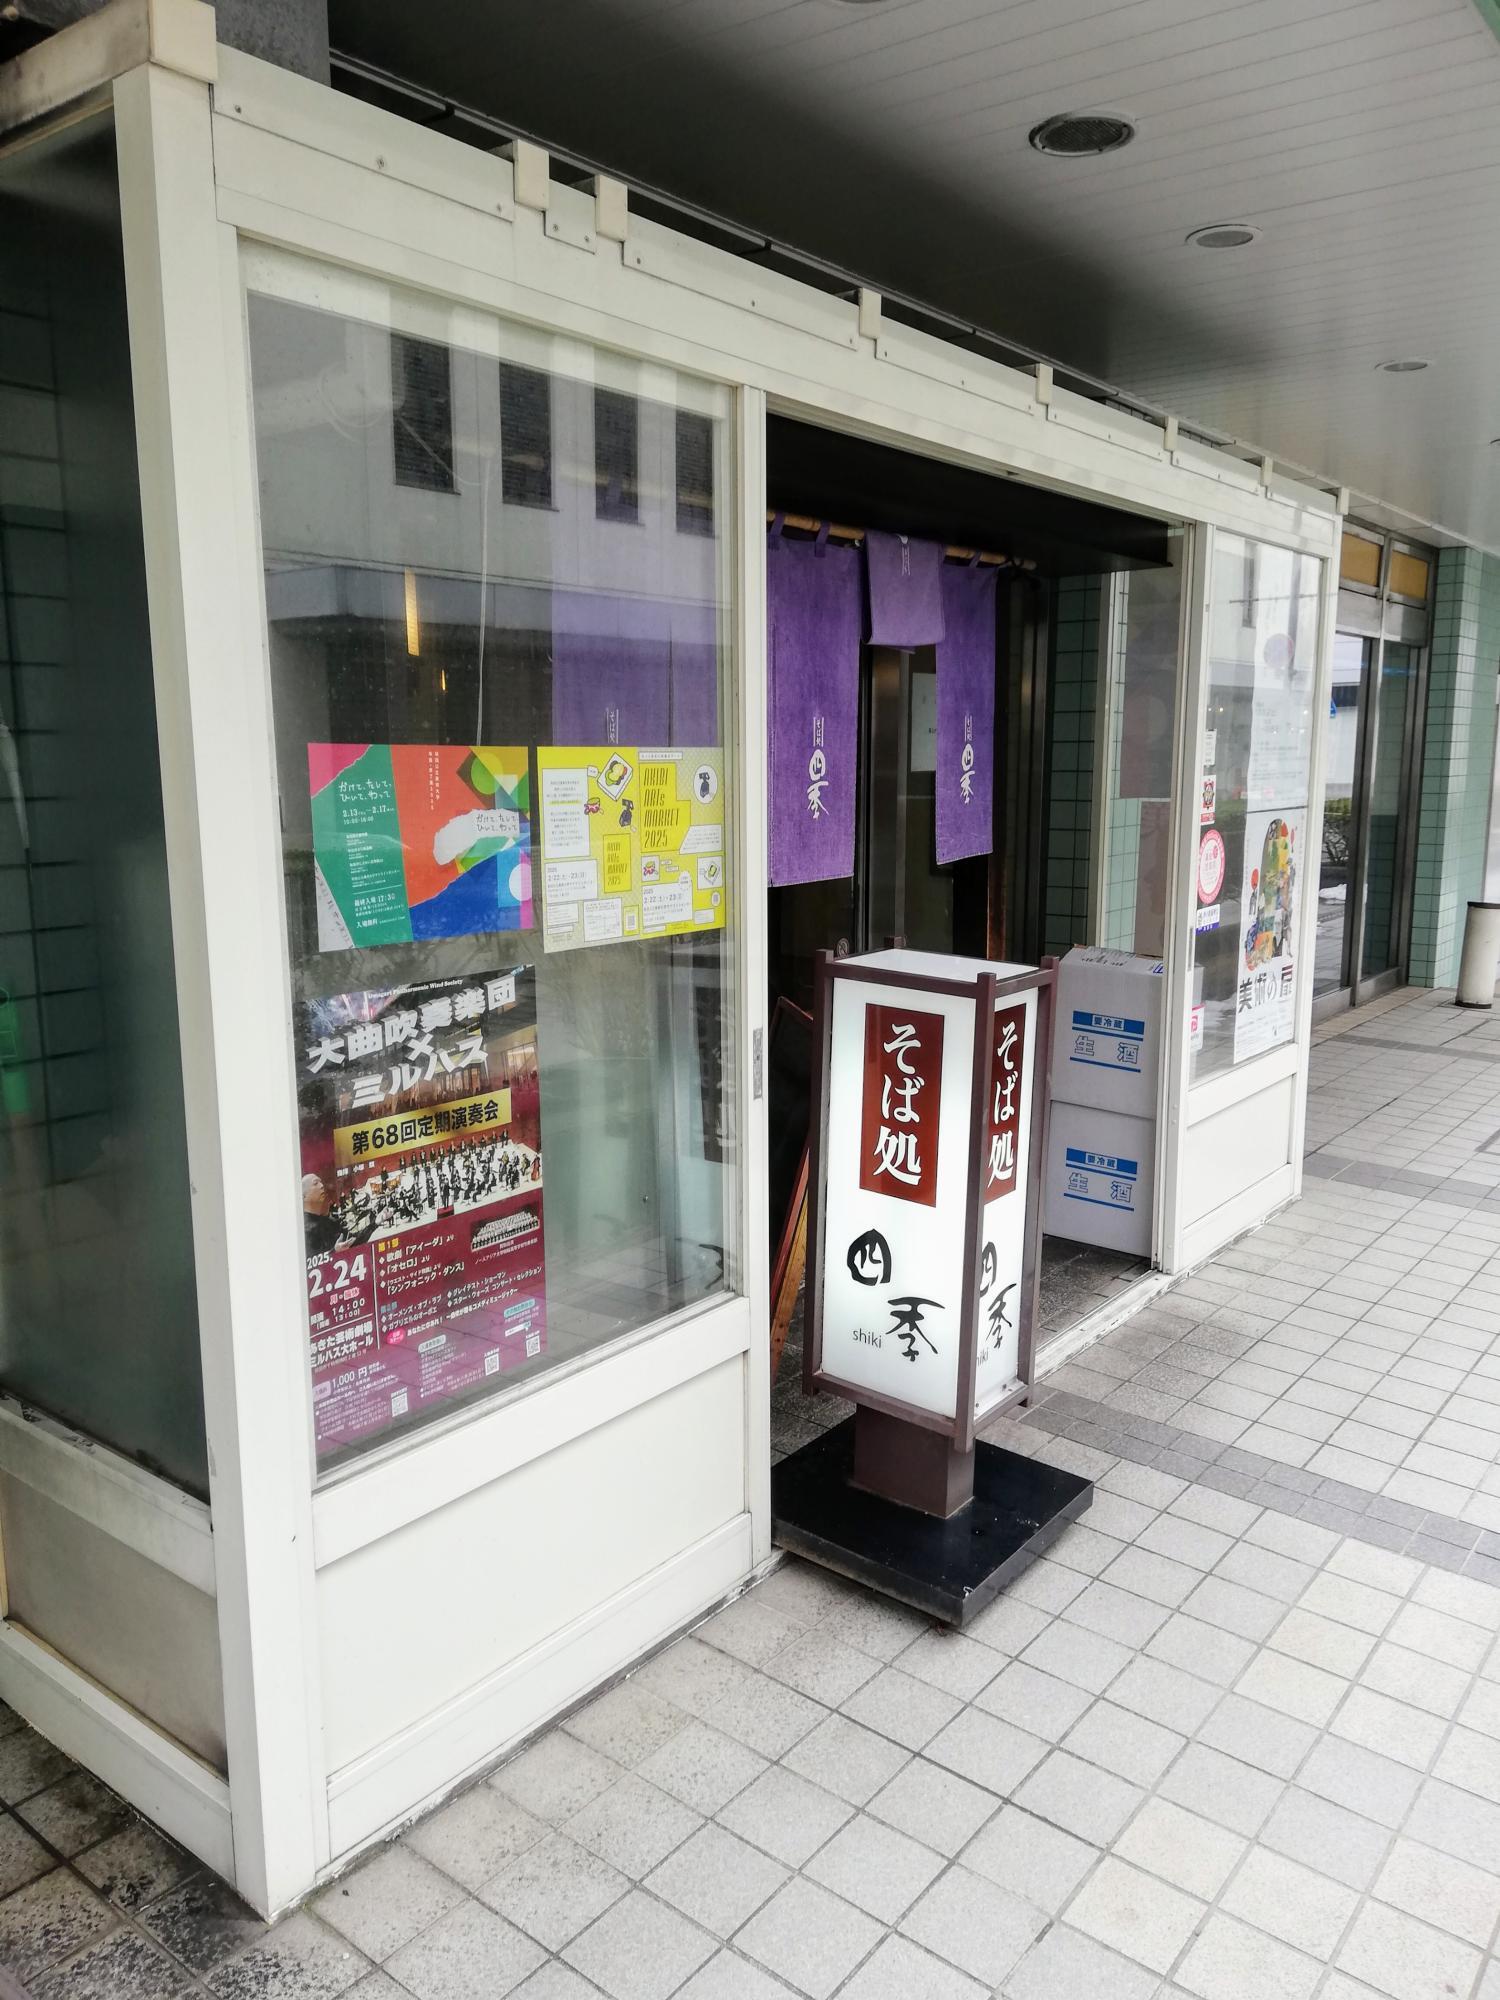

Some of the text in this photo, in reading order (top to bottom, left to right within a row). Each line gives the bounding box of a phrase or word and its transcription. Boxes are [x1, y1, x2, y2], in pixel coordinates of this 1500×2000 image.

[807, 749, 830, 820] 四季
[960, 743, 976, 805] 四季
[644, 830, 668, 848] 2025
[429, 981, 444, 989] Wind
[444, 979, 463, 987] Society
[306, 974, 516, 1074] 大曲吹奏楽団
[351, 1099, 499, 1155] 第68回定期演奏会
[872, 1022, 923, 1187] そば処
[987, 1020, 1019, 1188] そば処
[307, 1251, 334, 1270] 2025.
[308, 1254, 367, 1299] 2.24
[846, 1228, 946, 1362] 四季
[852, 1328, 882, 1349] shiki
